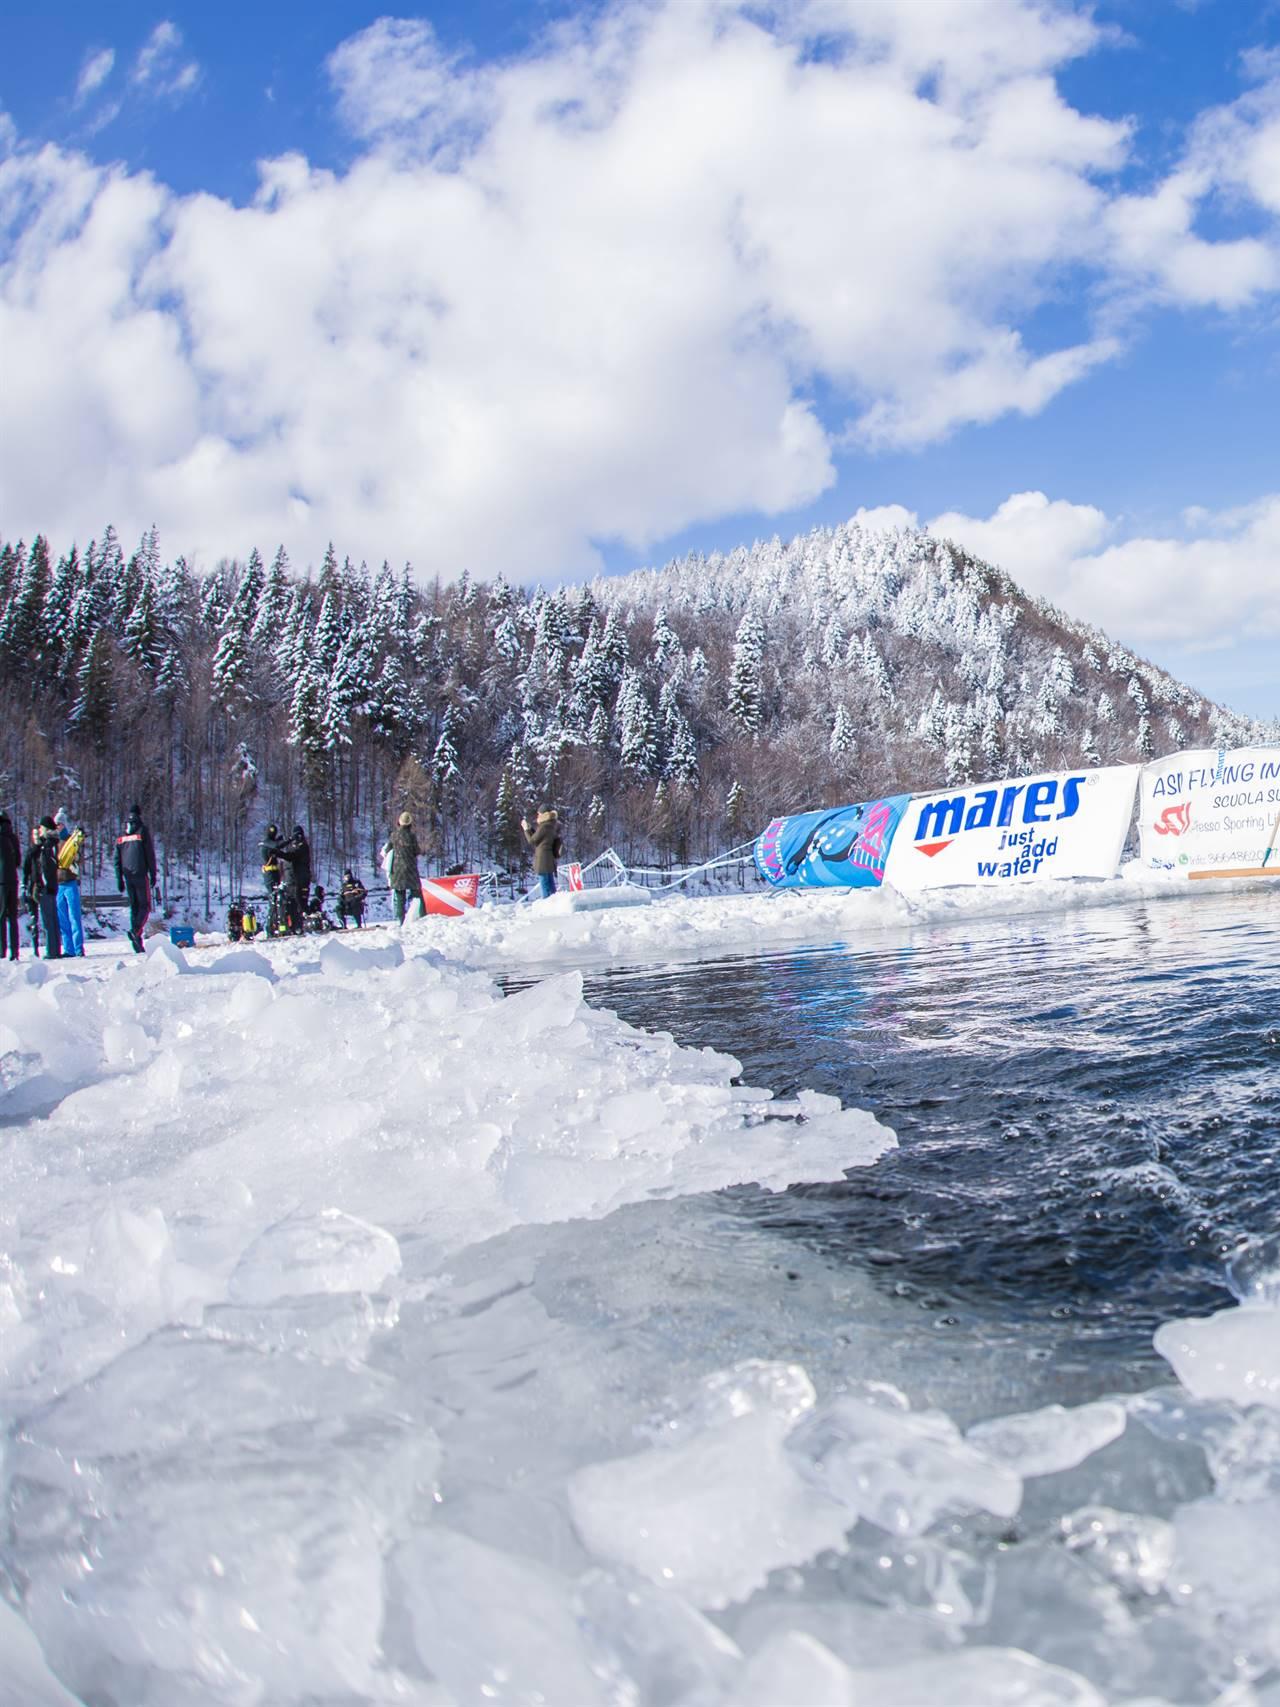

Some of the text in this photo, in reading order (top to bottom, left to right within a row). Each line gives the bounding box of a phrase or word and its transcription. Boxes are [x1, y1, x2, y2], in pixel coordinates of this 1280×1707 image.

[1188, 763, 1255, 790] FLYING
[914, 777, 1086, 841] mares
[1213, 791, 1264, 808] SCUOLA
[1223, 815, 1265, 834] Sporting
[998, 827, 1035, 850] just
[1021, 836, 1058, 858] add
[977, 857, 1043, 877] water
